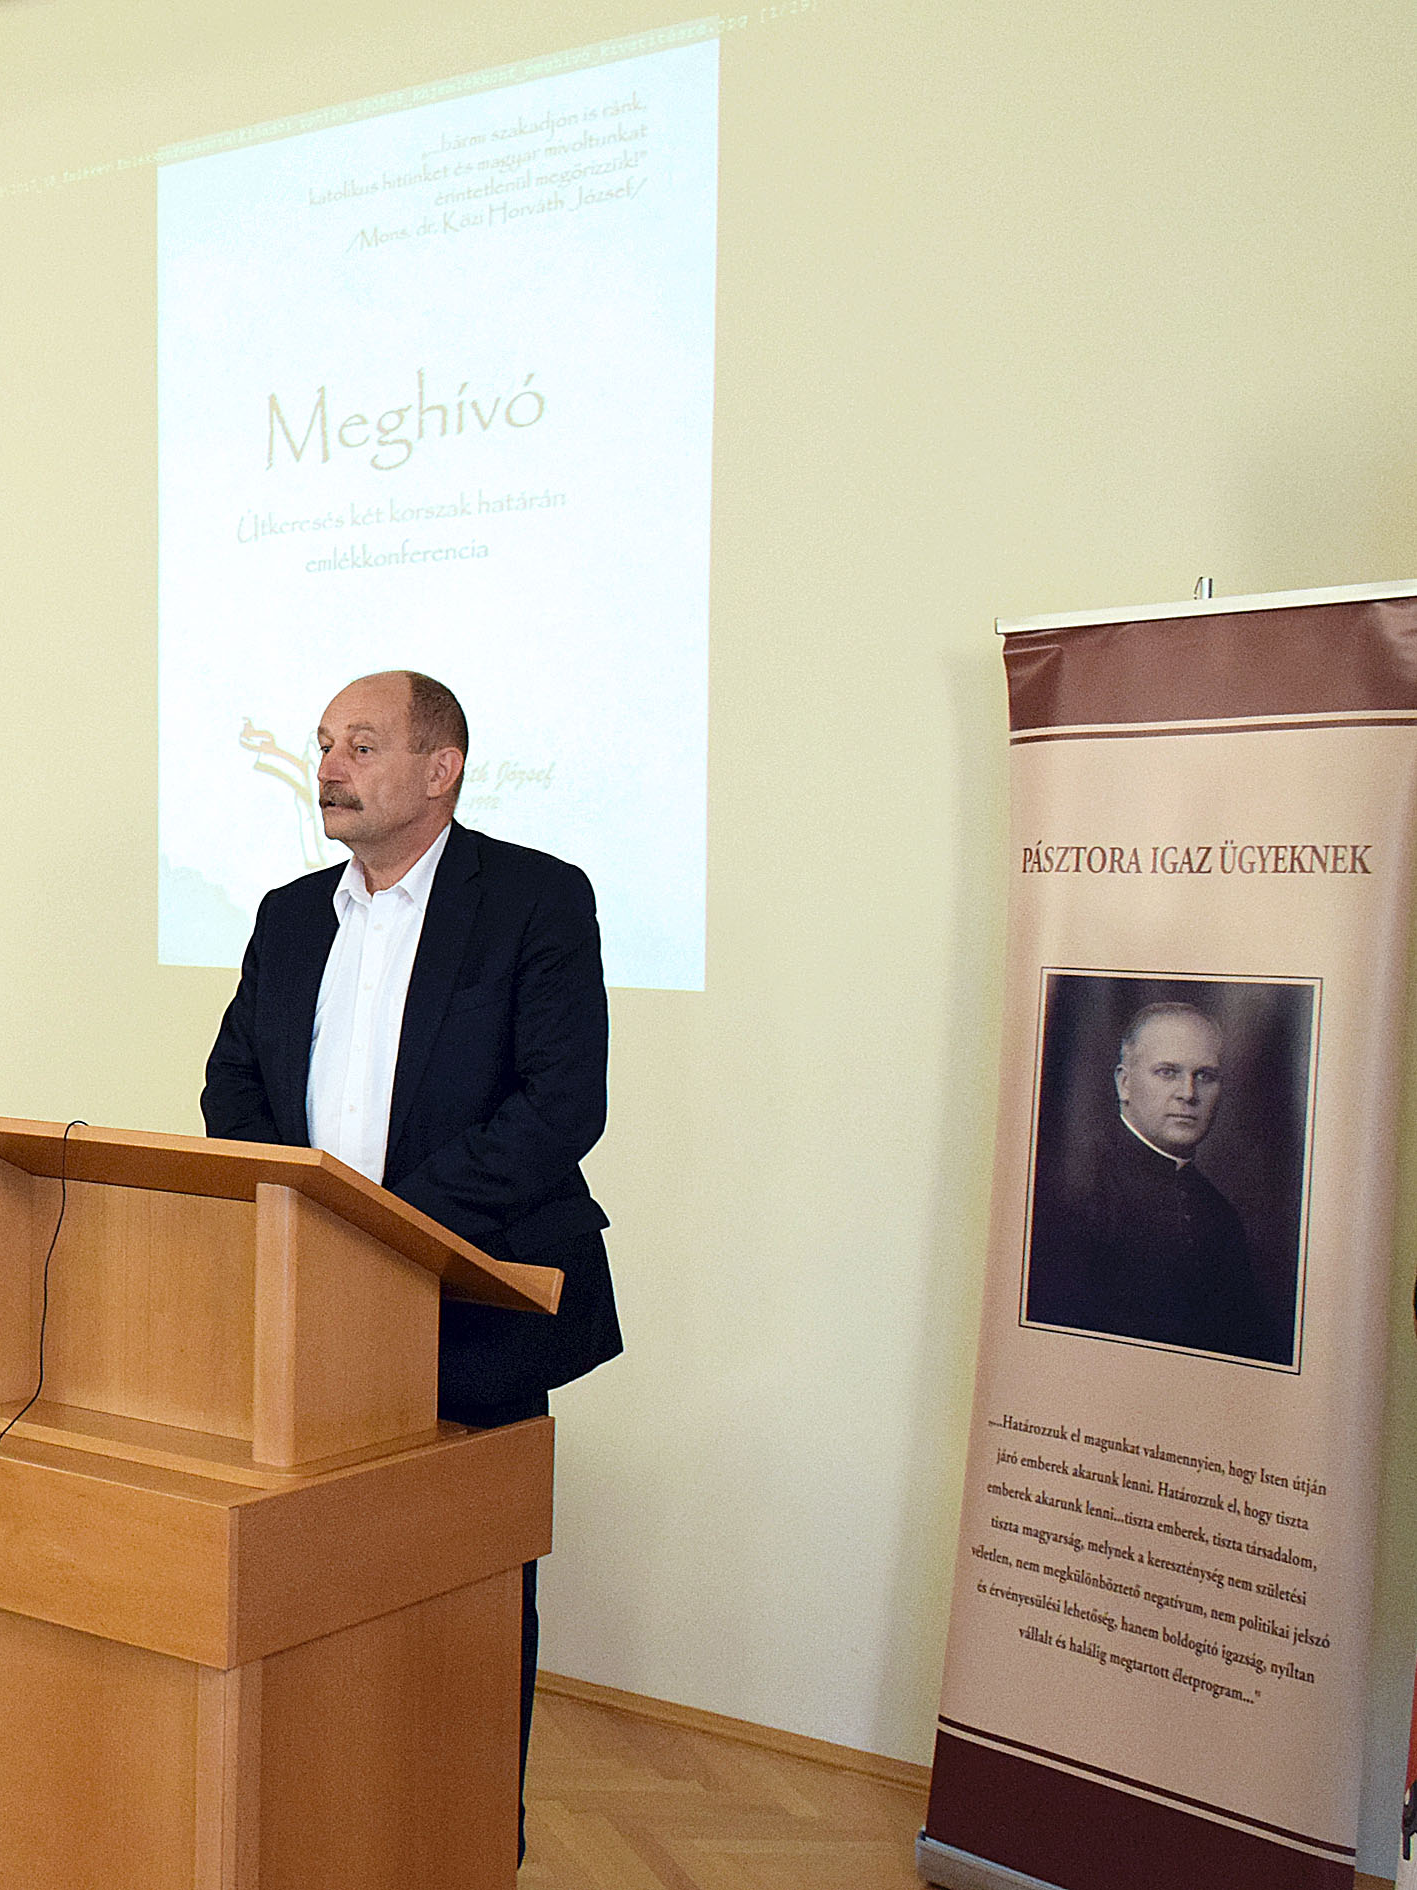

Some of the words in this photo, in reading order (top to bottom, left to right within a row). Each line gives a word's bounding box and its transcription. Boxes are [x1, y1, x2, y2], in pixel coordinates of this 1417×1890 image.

[491, 110, 578, 142] szakadjon
[583, 107, 598, 121] is
[309, 179, 379, 206] katolikus
[454, 161, 472, 175] és
[478, 149, 541, 174] magyar
[544, 122, 647, 156] mivoltunkat
[416, 216, 439, 236] dr.
[489, 190, 564, 226] Horváth
[266, 367, 545, 471] Meghívó
[350, 502, 381, 527] két
[390, 492, 472, 522] korszak
[478, 489, 567, 515] határán
[306, 539, 489, 573] emlékkonferencia
[1021, 840, 1142, 874] PÁSZTORA
[1150, 846, 1213, 874] IGAZ
[1219, 839, 1374, 875] ÜGYEKNEK
[997, 1448, 1018, 1465] járó
[1021, 1456, 1069, 1476] emberek
[1072, 1464, 1119, 1488] akarunk
[1122, 1473, 1154, 1494] lenni.
[1158, 1481, 1225, 1511] Határozzuk
[1227, 1498, 1241, 1516] el,
[1244, 1501, 1273, 1525] hogy
[1276, 1510, 1309, 1530] tiszta
[1071, 1428, 1081, 1443] el
[1084, 1438, 1140, 1454] magunkat
[1144, 1445, 1226, 1475] valamennyien,
[1229, 1461, 1257, 1485] hogy
[1260, 1468, 1289, 1489] Isten
[1293, 1475, 1327, 1497] útján
[987, 1482, 1032, 1503] emberek
[1035, 1490, 1083, 1514] akarunk
[1157, 1521, 1209, 1545] emberek,
[1213, 1532, 1243, 1552] tiszta
[1246, 1540, 1318, 1572] társadalom,
[991, 1516, 1019, 1534] tiszta
[1022, 1523, 1085, 1552] magyarság,
[1087, 1540, 1136, 1562] melynek
[1138, 1553, 1144, 1564] a
[1147, 1551, 1225, 1589] kereszténység
[1228, 1575, 1252, 1592] nem
[1256, 1582, 1307, 1606] születési
[971, 1544, 1013, 1568] véletlen,
[1016, 1558, 1040, 1573] nem
[1144, 1590, 1207, 1618] negatívum,
[1210, 1608, 1236, 1625] nem
[1239, 1614, 1290, 1639] politikai
[1292, 1628, 1331, 1649] jelszó
[977, 1579, 987, 1594] és
[989, 1583, 1061, 1614] érvényesülési
[1121, 1616, 1159, 1640] hanem
[1162, 1627, 1218, 1656] boldogító
[1221, 1644, 1267, 1675] igazság,
[1270, 1662, 1315, 1684] nyíltan
[1019, 1626, 1053, 1646] vállalt
[1055, 1634, 1067, 1650] és
[1069, 1637, 1107, 1665] halálig
[1110, 1653, 1170, 1680] megtartott
